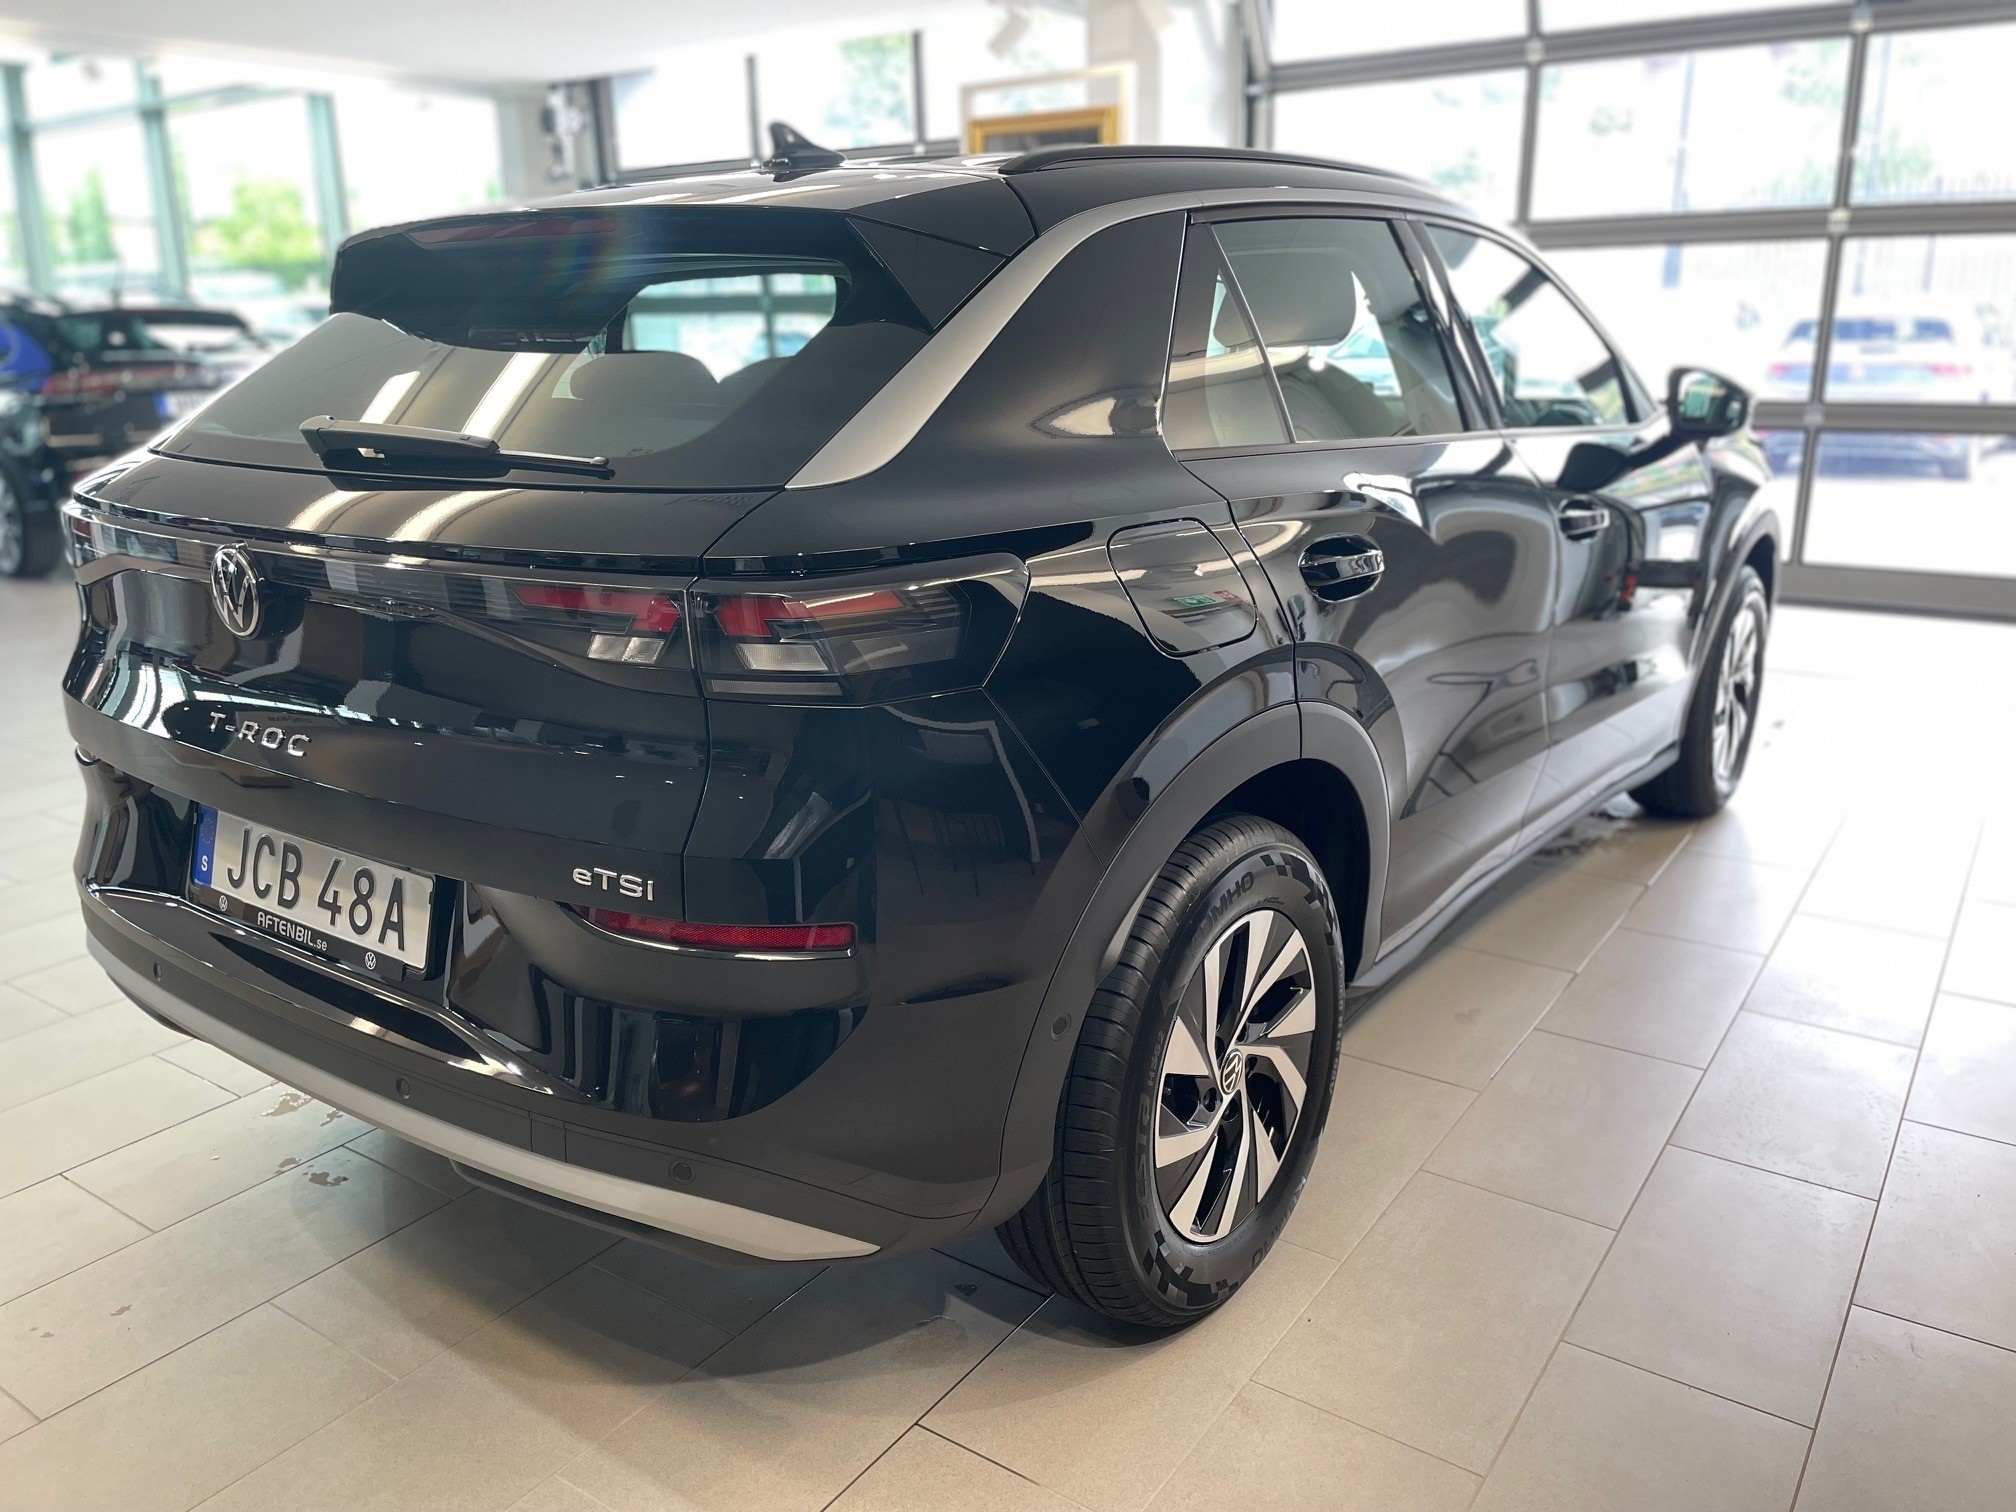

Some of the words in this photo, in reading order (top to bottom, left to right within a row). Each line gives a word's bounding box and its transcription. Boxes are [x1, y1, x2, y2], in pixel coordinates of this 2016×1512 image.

[210, 711, 312, 757] T-ROC
[201, 854, 209, 872] S
[227, 827, 303, 910] JCB
[317, 857, 405, 952] 48A
[256, 910, 329, 951] AFTENBIL.se
